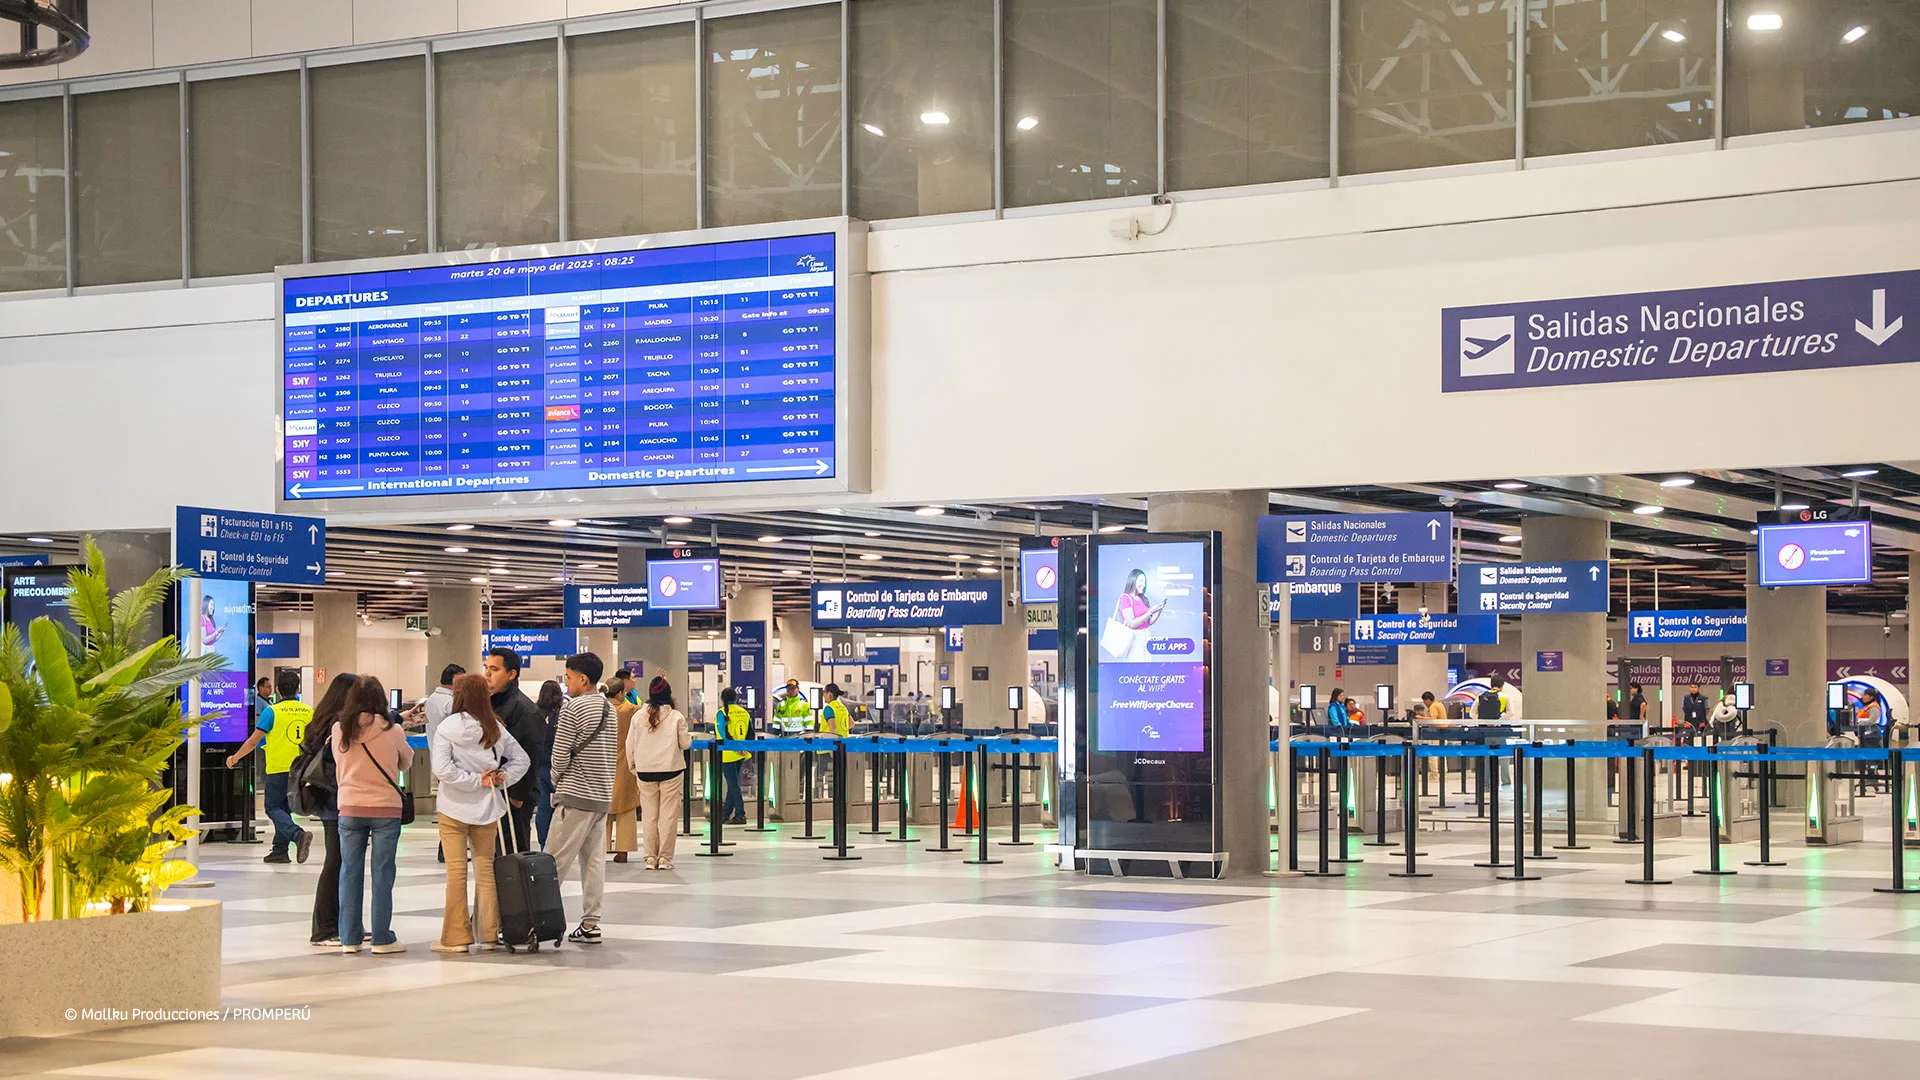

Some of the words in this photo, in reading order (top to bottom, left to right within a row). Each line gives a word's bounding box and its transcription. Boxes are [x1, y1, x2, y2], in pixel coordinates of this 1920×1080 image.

[451, 267, 484, 280] martes
[487, 268, 500, 277] 20
[503, 266, 516, 276] de
[518, 264, 546, 276] mayo
[549, 261, 565, 272] del
[567, 260, 594, 270] 2025
[604, 256, 635, 266] 08:25
[295, 290, 389, 308] DEPARTURES
[1528, 309, 1628, 341] Salidas
[1640, 296, 1805, 332] Nacionales
[368, 322, 408, 330] AEROPARQUE
[1526, 338, 1658, 373] Domestic
[1668, 330, 1839, 368] Departures
[644, 354, 673, 362] TRUJILLO
[548, 408, 570, 417] avianca
[640, 437, 678, 445] AYACUCHO
[588, 470, 652, 480] Domestic
[656, 467, 735, 480] Departures
[368, 478, 452, 490] International
[456, 476, 529, 488] Departures
[1813, 511, 1827, 520] LG
[221, 516, 260, 528] Facturación
[262, 521, 273, 530] E01
[281, 522, 293, 531] F15
[1311, 520, 1341, 529] Salidas
[1343, 520, 1386, 529] Nacionales
[220, 529, 249, 540] Check-in
[251, 532, 262, 541] E01
[272, 533, 284, 543] F15
[1310, 534, 1348, 542] Domestic
[1350, 533, 1397, 543] Departures
[220, 551, 244, 561] Control
[246, 553, 254, 562] de
[256, 554, 288, 565] Seguridad
[682, 549, 691, 557] LG
[1310, 555, 1341, 564] Control
[1343, 554, 1354, 563] de
[1357, 554, 1387, 565] Tarjeta
[1389, 554, 1400, 563] de
[1402, 553, 1445, 564] Embarque
[220, 566, 247, 576] Security
[248, 567, 272, 576] Control
[1309, 567, 1347, 578] Boarding
[1350, 566, 1368, 576] Pass
[1371, 566, 1403, 575] Control
[1526, 566, 1562, 574] Nacionales
[14, 577, 36, 585] ARTE
[1499, 576, 1529, 584] Domestic
[1531, 575, 1567, 584] Departures
[1290, 582, 1341, 596] Embarque
[846, 590, 879, 602] Control
[881, 590, 892, 602] de
[895, 590, 925, 604] Tarjeta
[928, 590, 939, 601] de
[942, 589, 988, 603] Embarque
[1500, 592, 1524, 600] Control
[1536, 592, 1569, 600] Seguridad
[1499, 602, 1526, 610] Security
[618, 608, 642, 617] Seguridad
[846, 606, 886, 620] Boarding
[888, 606, 908, 617] Pass
[910, 605, 944, 617] Control
[1028, 610, 1052, 622] SALIDA
[593, 617, 612, 625] Security
[1377, 619, 1405, 629] Control
[1407, 619, 1416, 628] de
[1658, 616, 1689, 626] Control
[1692, 616, 1701, 625] de
[1704, 615, 1747, 627] Seguridad
[491, 634, 511, 642] Control
[512, 634, 519, 642] de
[521, 634, 548, 643] Seguridad
[1377, 630, 1408, 641] Security
[1409, 630, 1435, 639] Control
[1658, 628, 1692, 639] Security
[1694, 628, 1723, 637] Control
[1314, 636, 1321, 650] 8
[838, 642, 851, 656] 10
[856, 642, 865, 656] 10
[1119, 674, 1159, 684] CONÉCTATE
[1161, 675, 1185, 684] GRATIS
[296, 726, 300, 739] i
